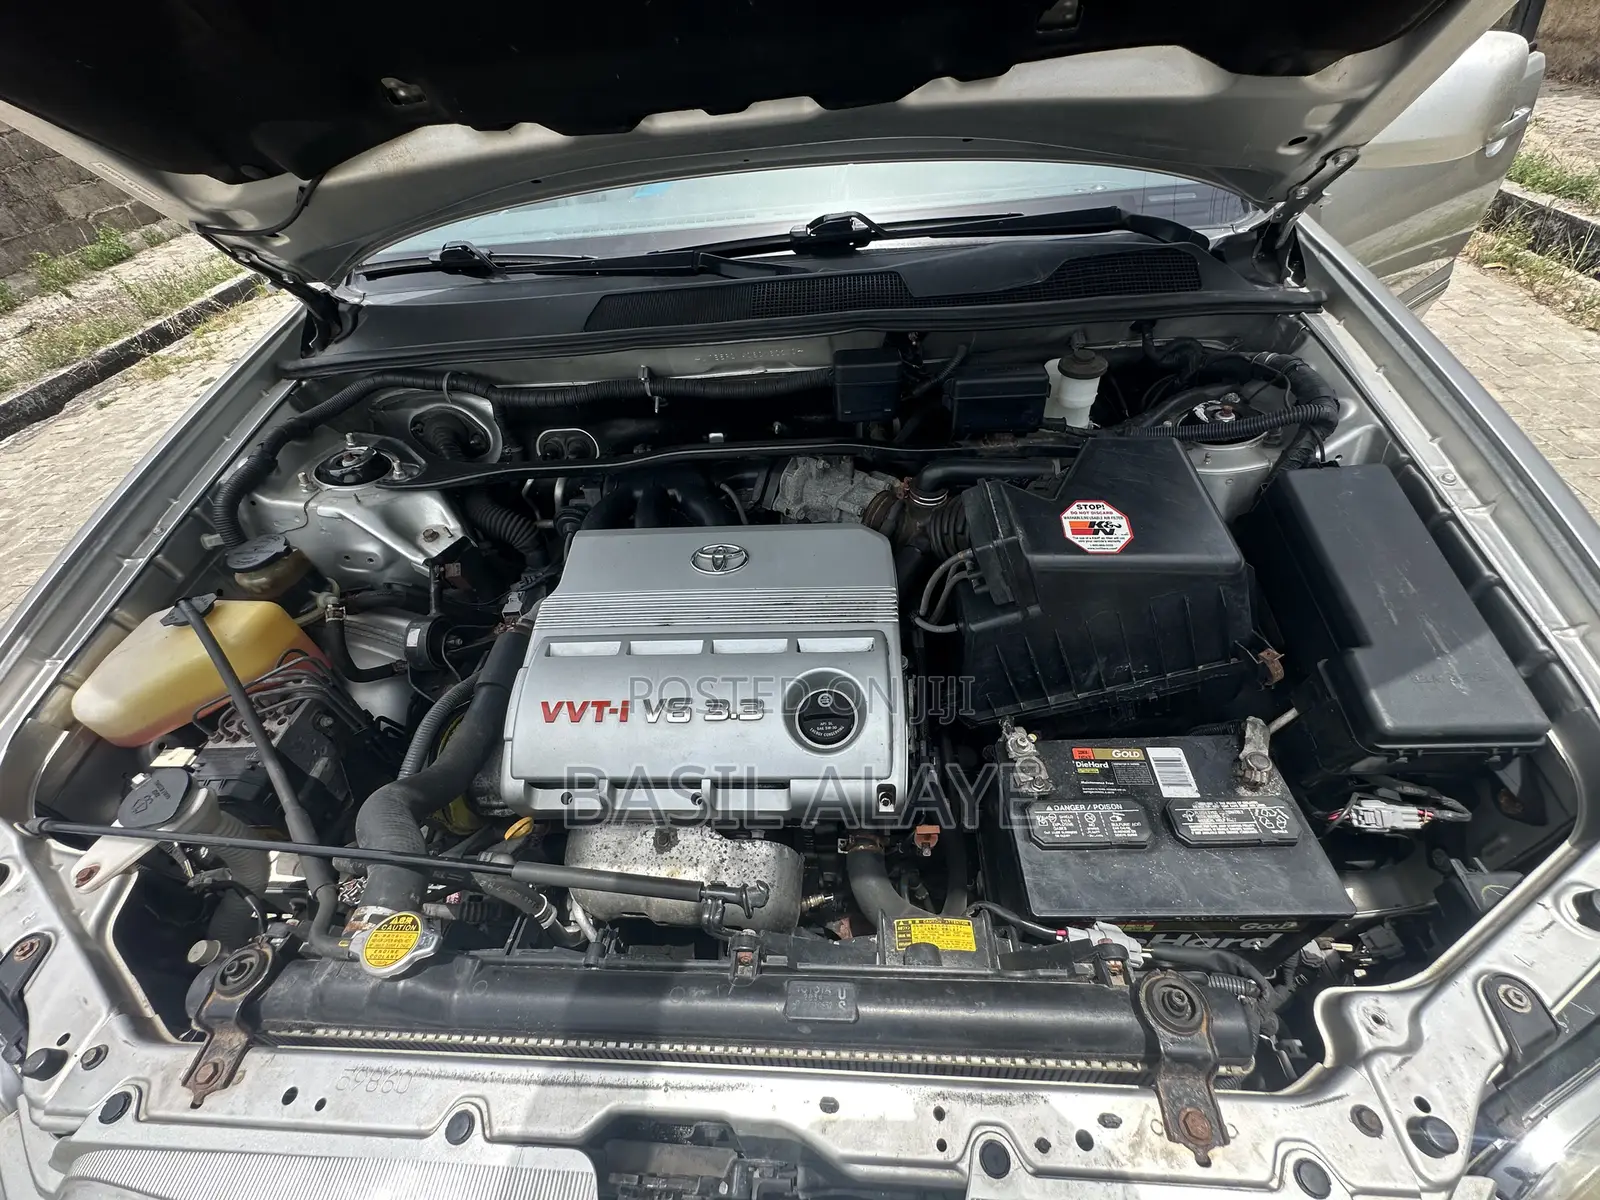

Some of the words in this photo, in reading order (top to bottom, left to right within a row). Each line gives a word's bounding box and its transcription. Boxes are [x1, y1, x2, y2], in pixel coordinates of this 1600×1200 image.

[541, 701, 629, 723] VVT-i
[643, 698, 692, 723] V6
[703, 699, 764, 721] 3.3
[810, 727, 823, 737] ENERGY
[823, 726, 845, 737] CONSERVING
[1111, 749, 1140, 758] GOLD
[1134, 933, 1283, 948] eHard
